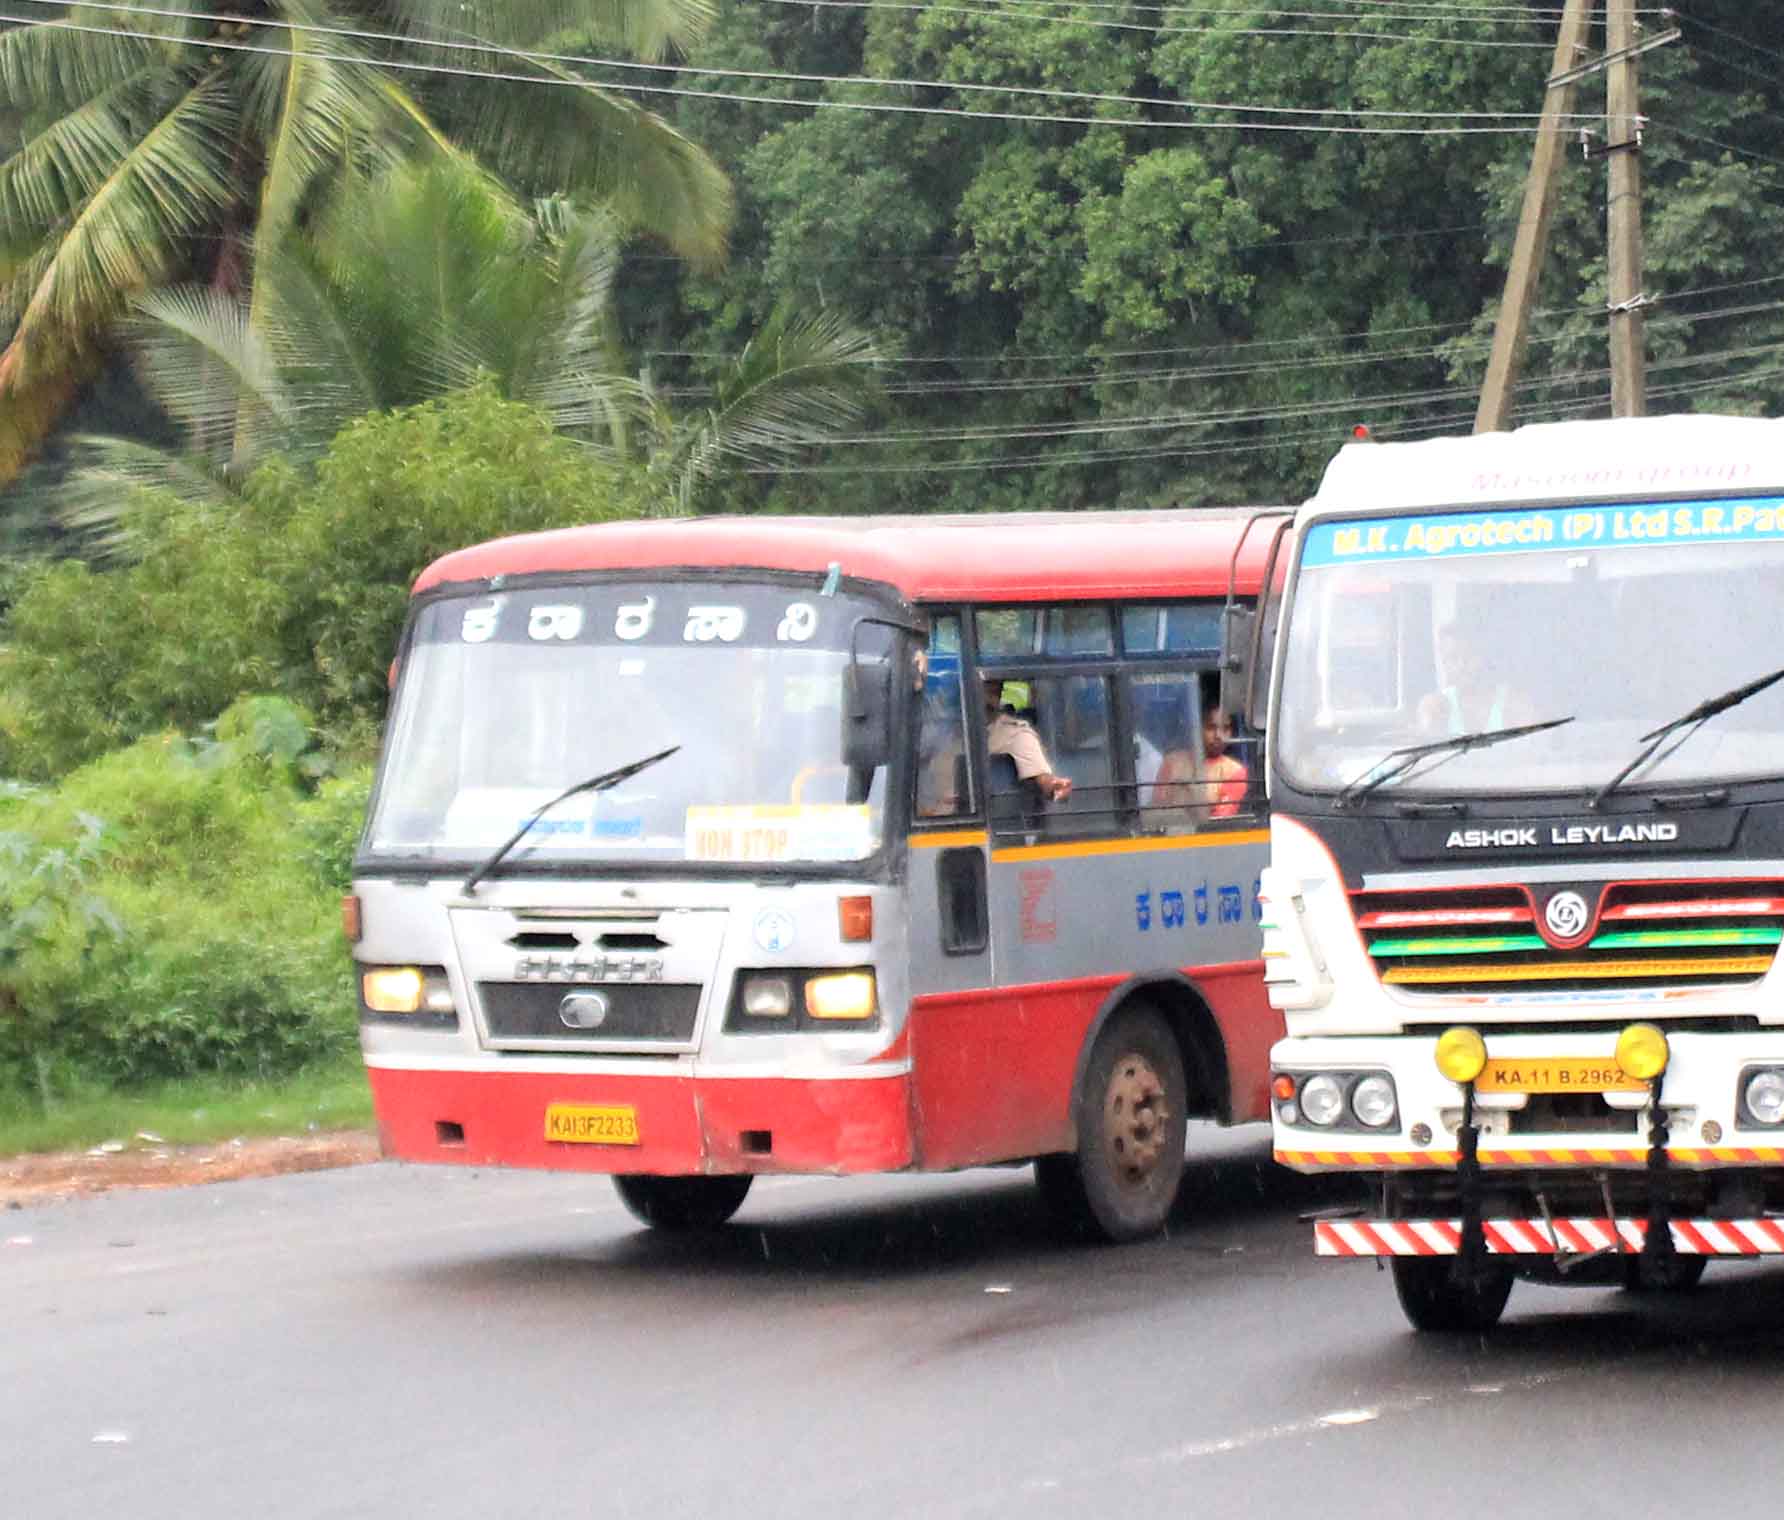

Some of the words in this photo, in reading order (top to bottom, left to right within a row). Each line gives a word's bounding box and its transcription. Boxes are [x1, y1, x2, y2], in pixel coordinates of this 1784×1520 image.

[1404, 515, 1554, 553] Agrotech
[1562, 513, 1604, 541] (P)
[1613, 509, 1669, 539] Ltd
[1446, 828, 1537, 848] ASHOK
[1551, 823, 1679, 845] LEYLAND
[1495, 1069, 1550, 1085] KA.11
[1559, 1069, 1626, 1085] B.2962
[550, 1114, 635, 1138] KA13F2233
